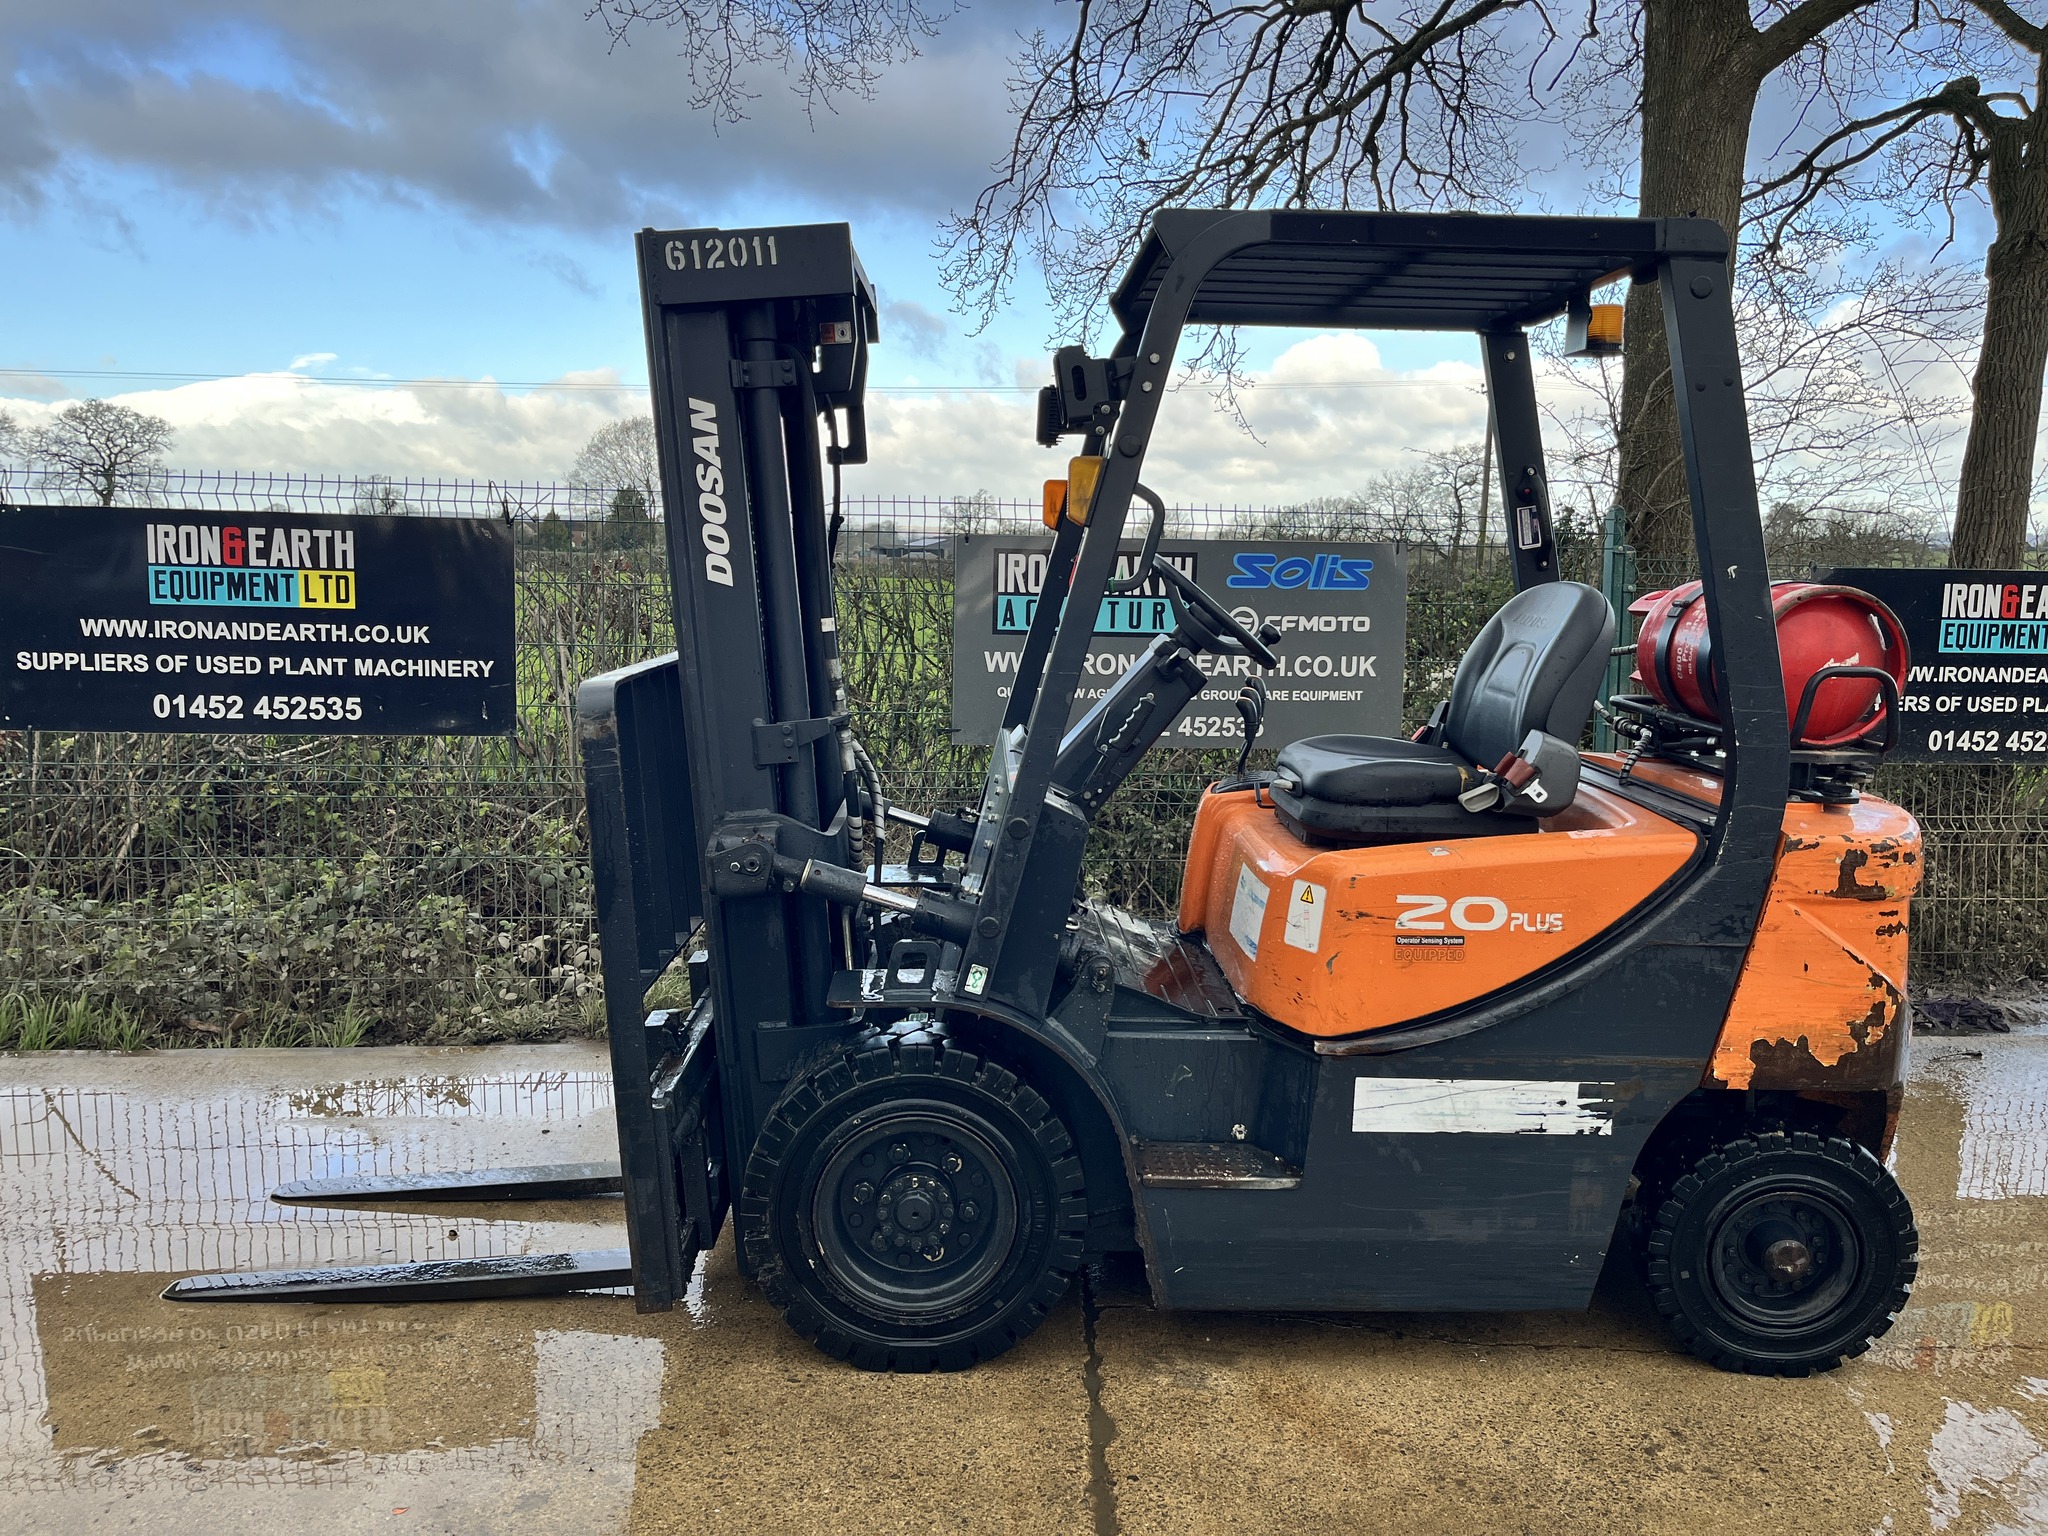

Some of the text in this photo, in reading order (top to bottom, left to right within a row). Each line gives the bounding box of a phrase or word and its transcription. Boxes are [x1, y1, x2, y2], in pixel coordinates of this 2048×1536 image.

[665, 235, 777, 271] 612011
[688, 397, 734, 588] DOOSAN
[154, 570, 350, 604] EQUIPMENT LTD
[80, 618, 430, 644] WWW.IRONANDEARTH.CO.UK
[16, 651, 495, 678] SUPPLIERS OF USED PLANT MACHINERY
[153, 694, 363, 721] 01452 452535
[1292, 690, 1363, 701] EQUIPMENT
[1936, 696, 1963, 712] OF
[1967, 697, 2018, 713] USED
[1928, 730, 2048, 752] 01452 452
[1395, 895, 1563, 932] 20 PLUS
[1396, 936, 1420, 944] Operator
[1421, 937, 1443, 945] Sensing
[1394, 948, 1465, 961] EQUIPPED
